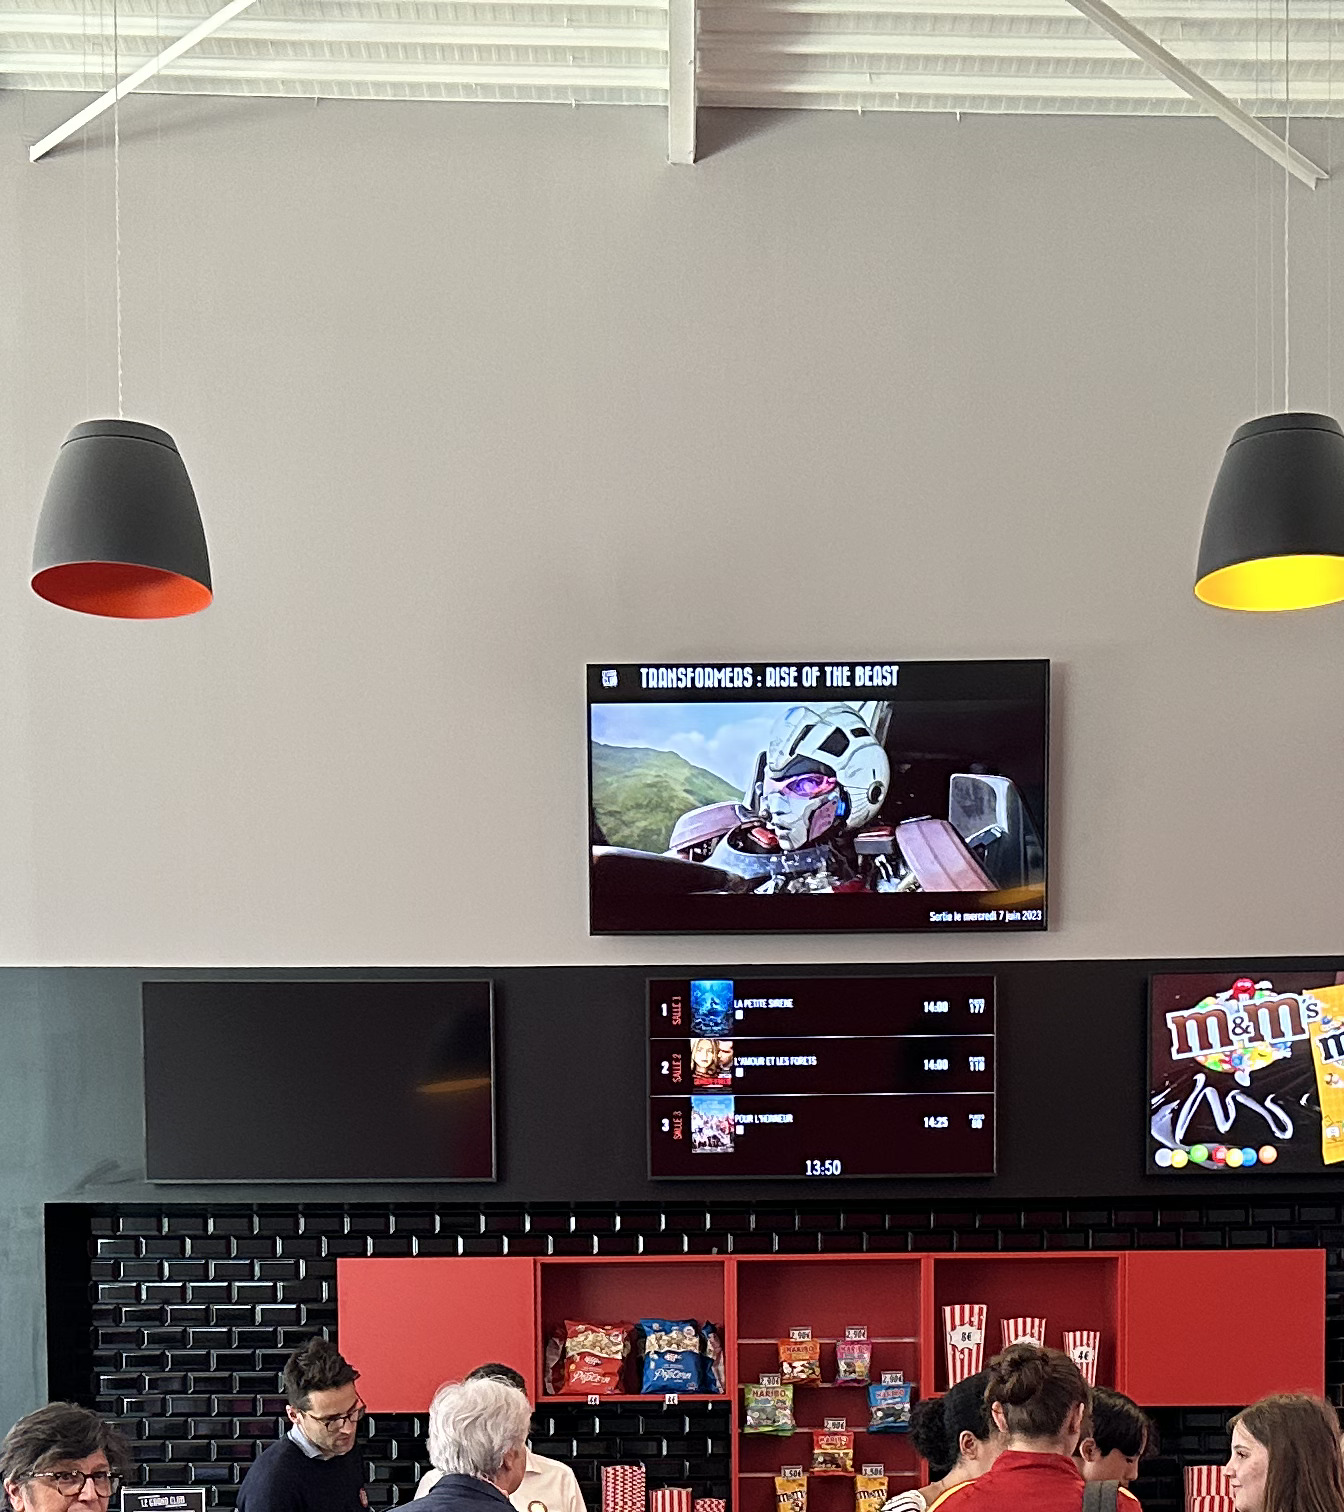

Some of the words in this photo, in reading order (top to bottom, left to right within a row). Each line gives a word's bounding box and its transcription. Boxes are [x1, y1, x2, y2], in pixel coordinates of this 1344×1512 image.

[640, 667, 753, 689] TRANSFORMERS
[766, 667, 798, 688] RISE
[802, 667, 821, 687] OF
[825, 666, 851, 687] THE
[855, 665, 900, 687] BEAST
[930, 911, 953, 922] Sortie
[954, 911, 962, 921] le
[963, 910, 997, 921] mercredi
[998, 910, 1005, 921] 7
[1005, 910, 1021, 923] juin
[1022, 910, 1042, 921] 2023
[661, 1002, 669, 1017] 1
[661, 1060, 669, 1075] 2
[661, 1118, 670, 1133] 3
[923, 1116, 949, 1128] 14:25
[805, 1159, 842, 1176] 13:50
[752, 1388, 786, 1398] HARIBO
